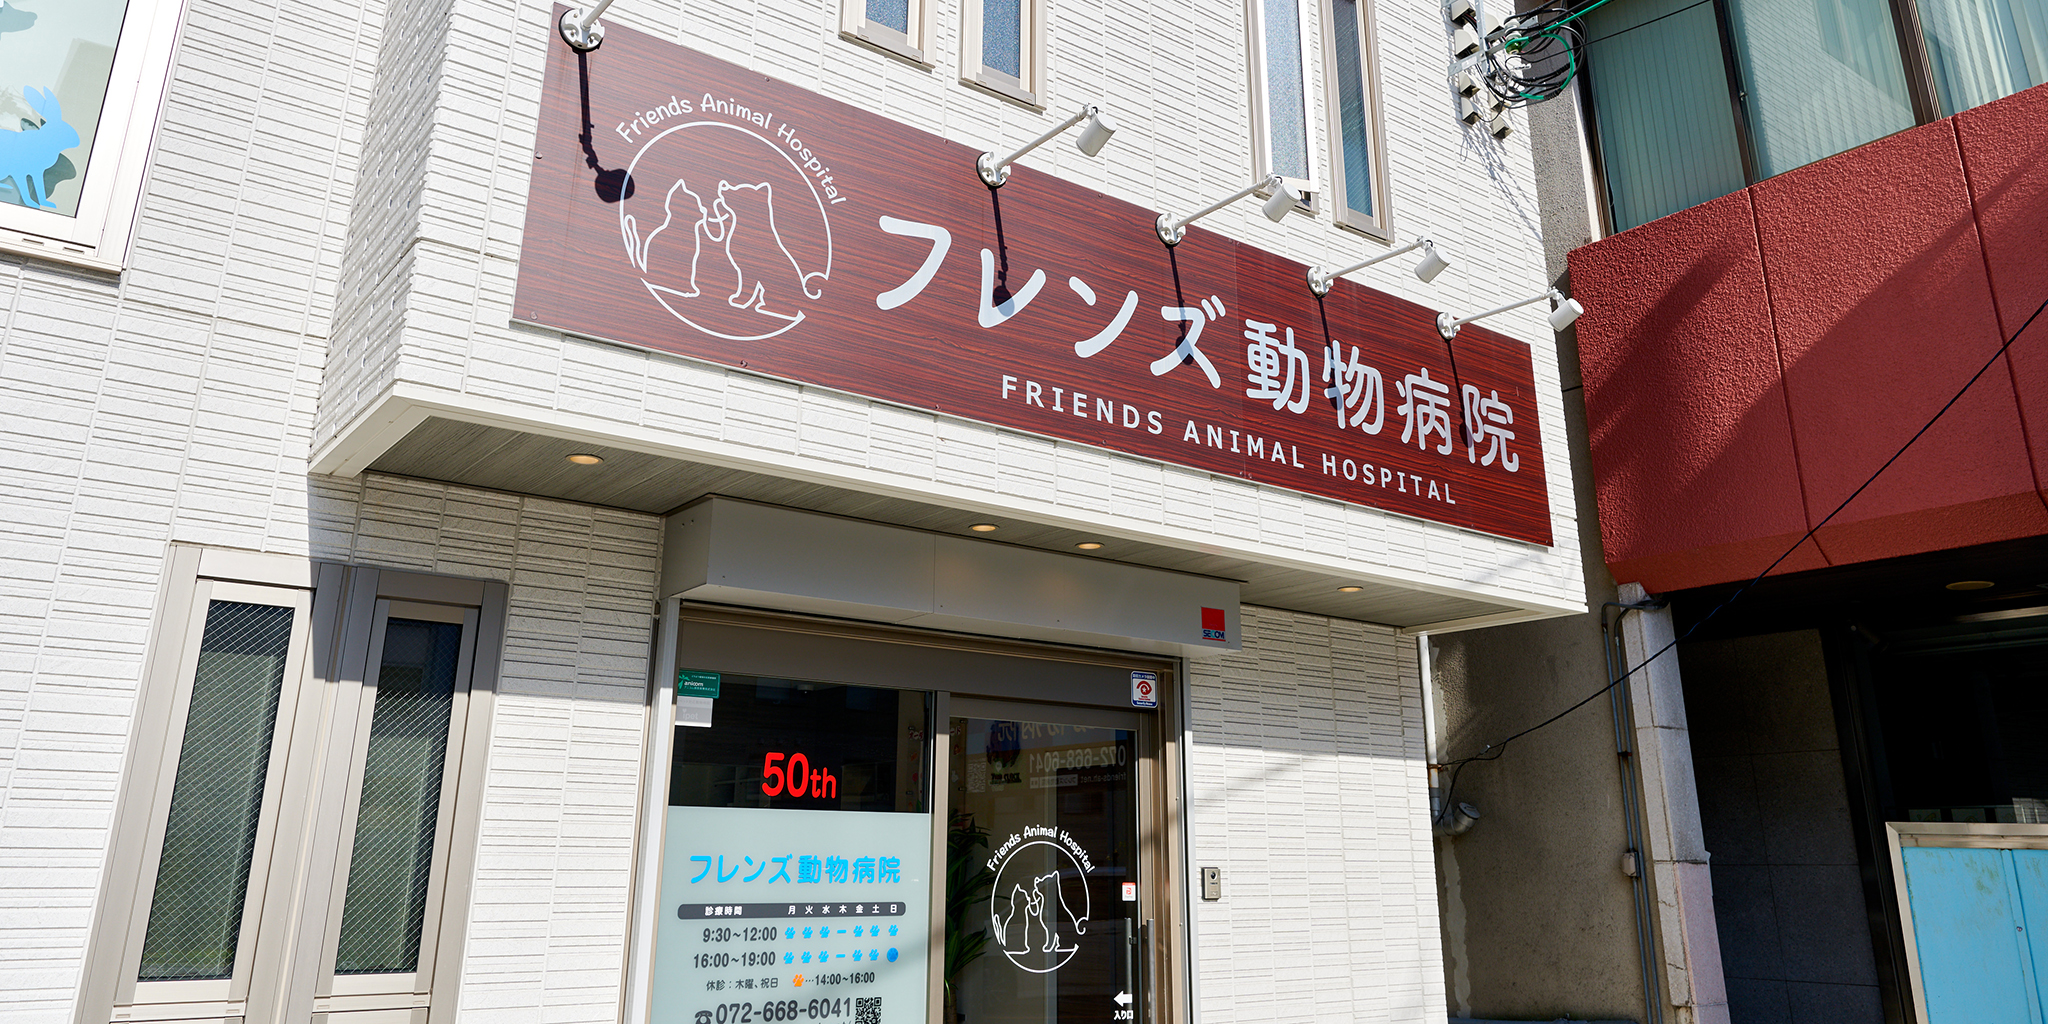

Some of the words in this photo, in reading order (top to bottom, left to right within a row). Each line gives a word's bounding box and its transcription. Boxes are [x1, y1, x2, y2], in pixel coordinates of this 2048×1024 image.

[615, 95, 694, 144] Friends
[700, 93, 773, 130] Animal
[777, 123, 847, 205] Hospital
[876, 215, 1520, 474] フレンズ動物病院
[1002, 374, 1163, 435] FRIENDS
[1183, 420, 1305, 469] ANIMAL
[1321, 453, 1457, 505] HOSPITAL
[1203, 630, 1225, 639] SECOM
[761, 751, 837, 799] 50th
[986, 831, 1022, 872] Friends
[1023, 824, 1058, 839] Animal
[1059, 830, 1096, 874] Hospital
[690, 853, 901, 884] フレンズ動物病院
[704, 905, 743, 916] 診療時間
[788, 905, 796, 915] 月
[804, 905, 813, 915] 火
[821, 904, 831, 914] 水
[838, 904, 847, 914] 木
[855, 904, 864, 914] 金
[872, 904, 880, 914] 土
[890, 904, 897, 913] 日
[702, 926, 778, 943] 9:30~12:00
[693, 951, 776, 968] 16:00~19:00
[715, 997, 851, 1024] 072-668-6041
[1113, 1009, 1134, 1021] 入り口
